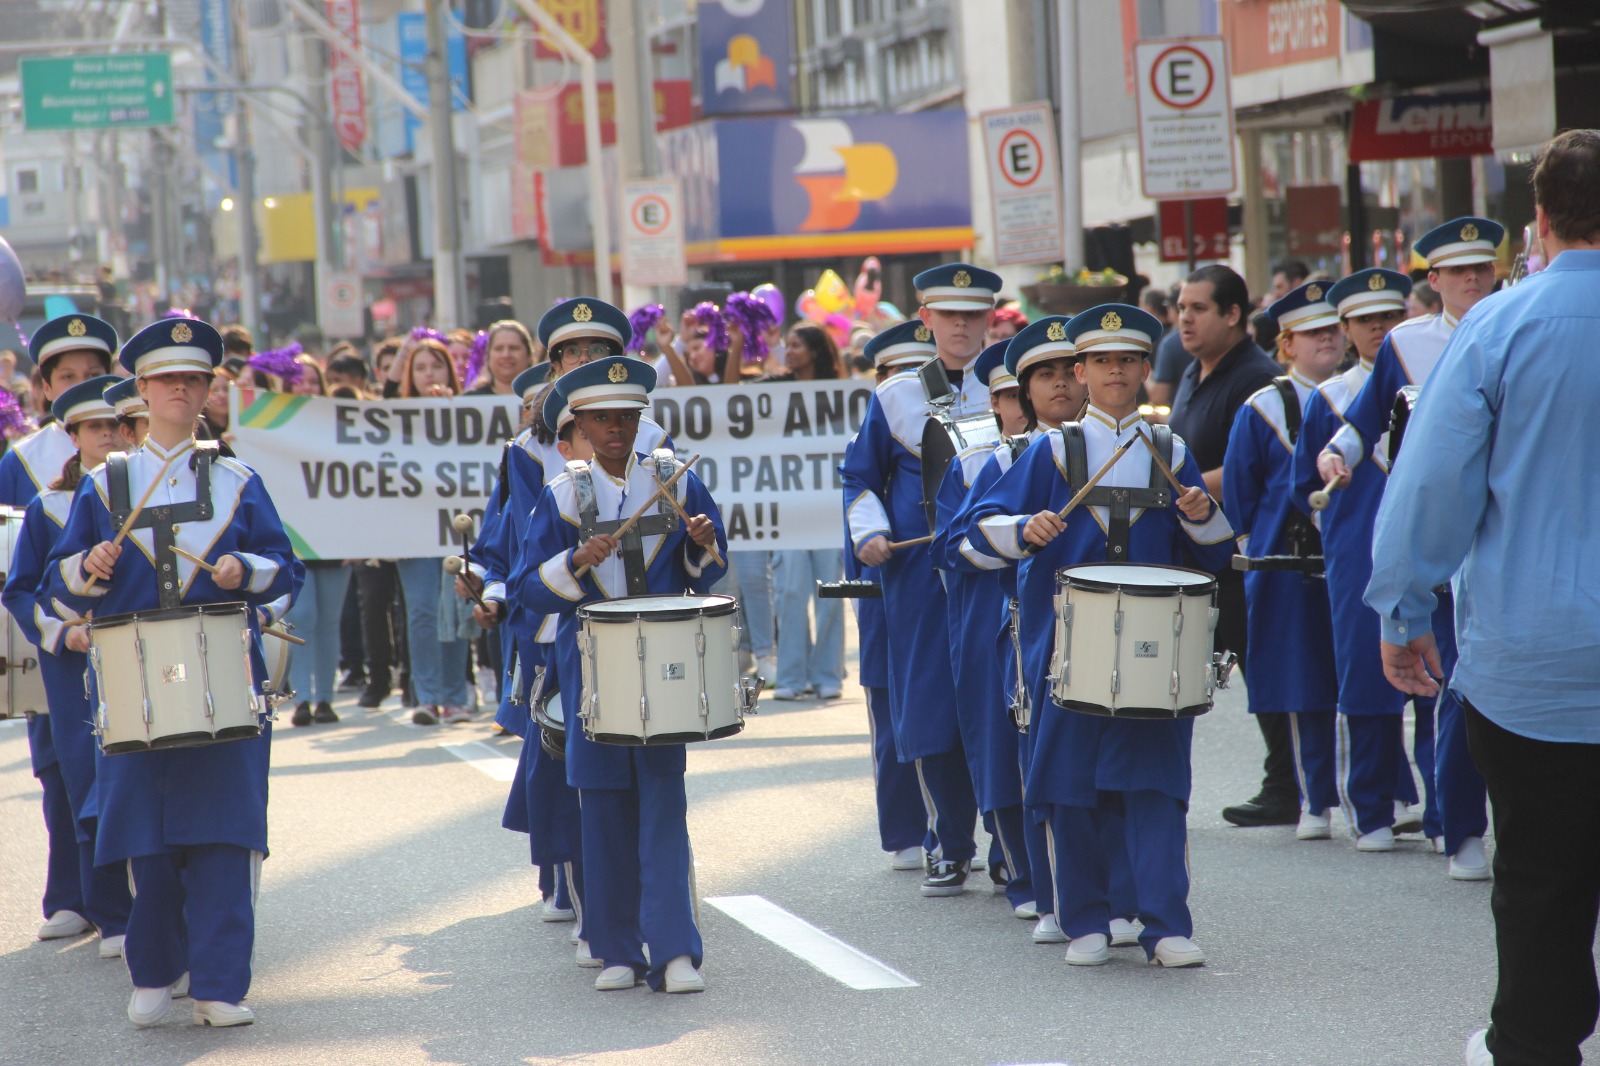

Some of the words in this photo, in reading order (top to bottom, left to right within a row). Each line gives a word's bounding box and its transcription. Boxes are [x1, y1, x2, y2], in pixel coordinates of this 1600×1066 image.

[1268, 0, 1328, 55] ESPORTES
[1169, 60, 1194, 95] E
[1011, 143, 1031, 173] E
[642, 203, 659, 225] E
[336, 404, 523, 446] ESTUDA
[654, 396, 712, 441] DO
[301, 452, 423, 499] VOCÊS
[719, 502, 779, 540] A!!
